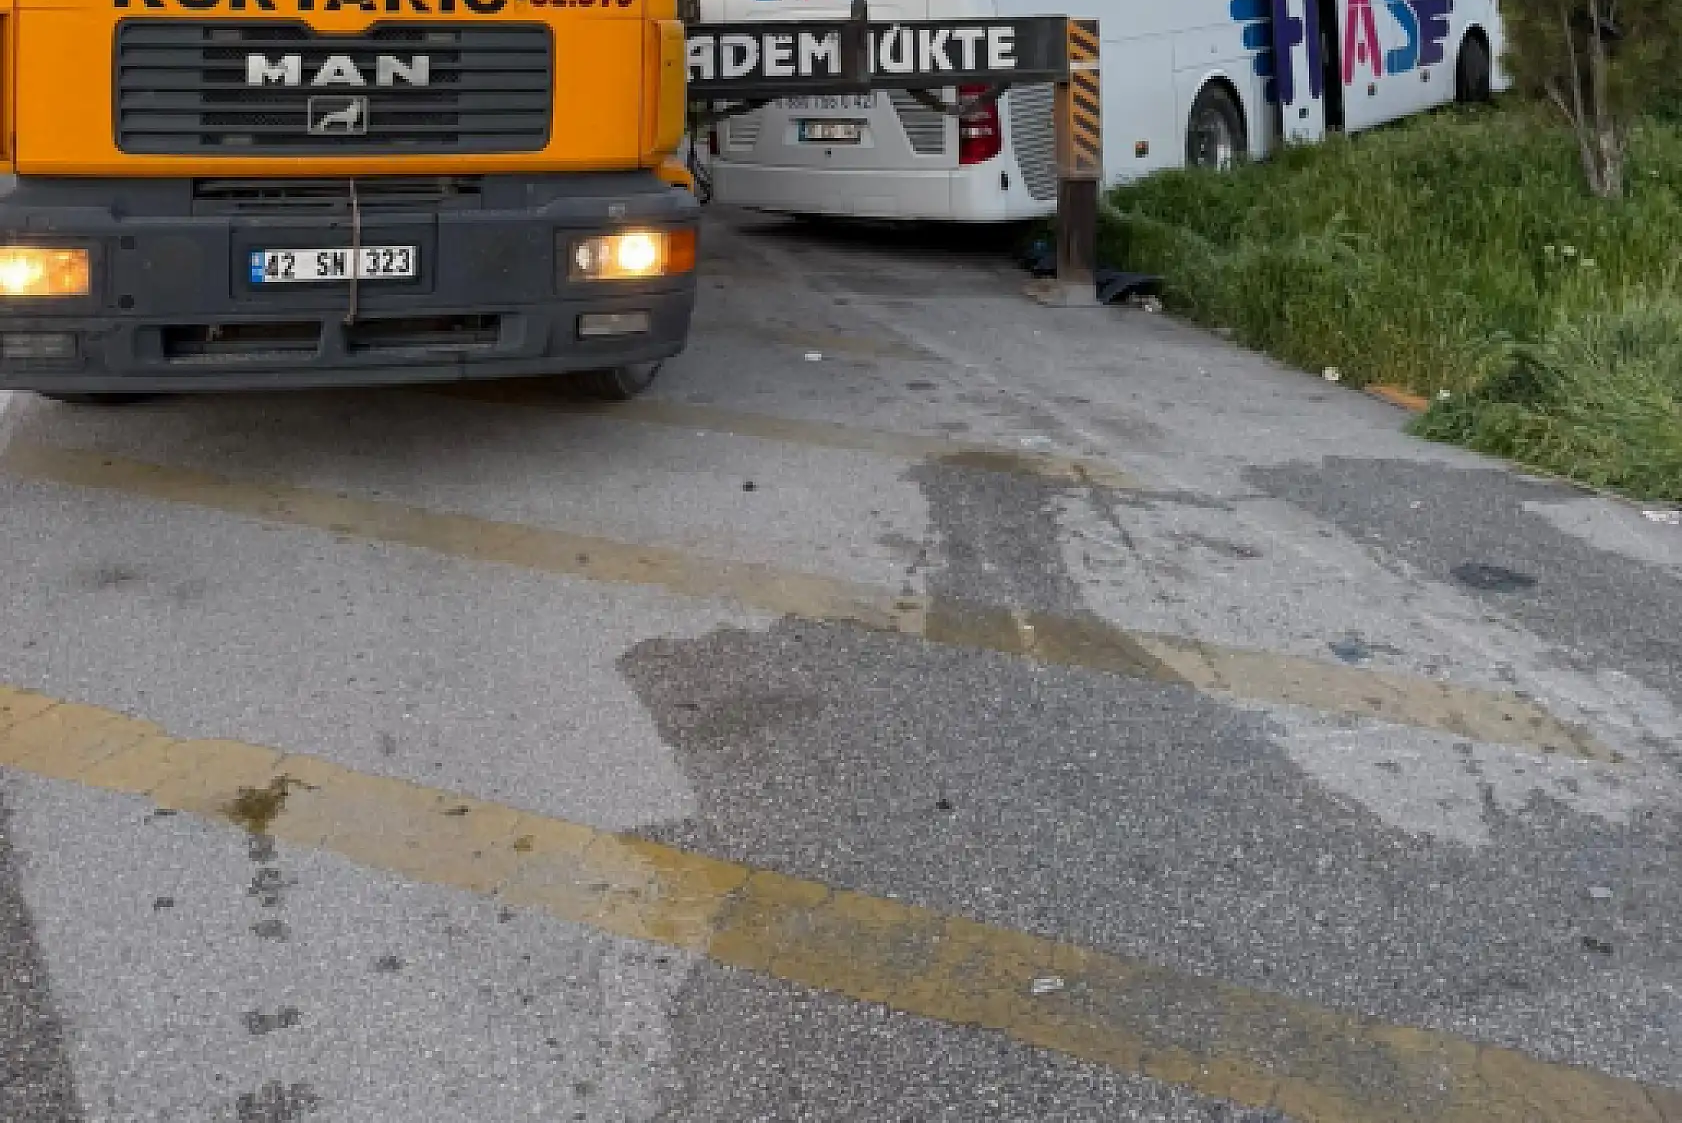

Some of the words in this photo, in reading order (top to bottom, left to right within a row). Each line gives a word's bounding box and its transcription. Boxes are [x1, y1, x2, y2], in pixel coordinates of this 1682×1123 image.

[246, 53, 431, 87] MAN
[685, 30, 842, 82] ADEM
[365, 248, 411, 275] 323
